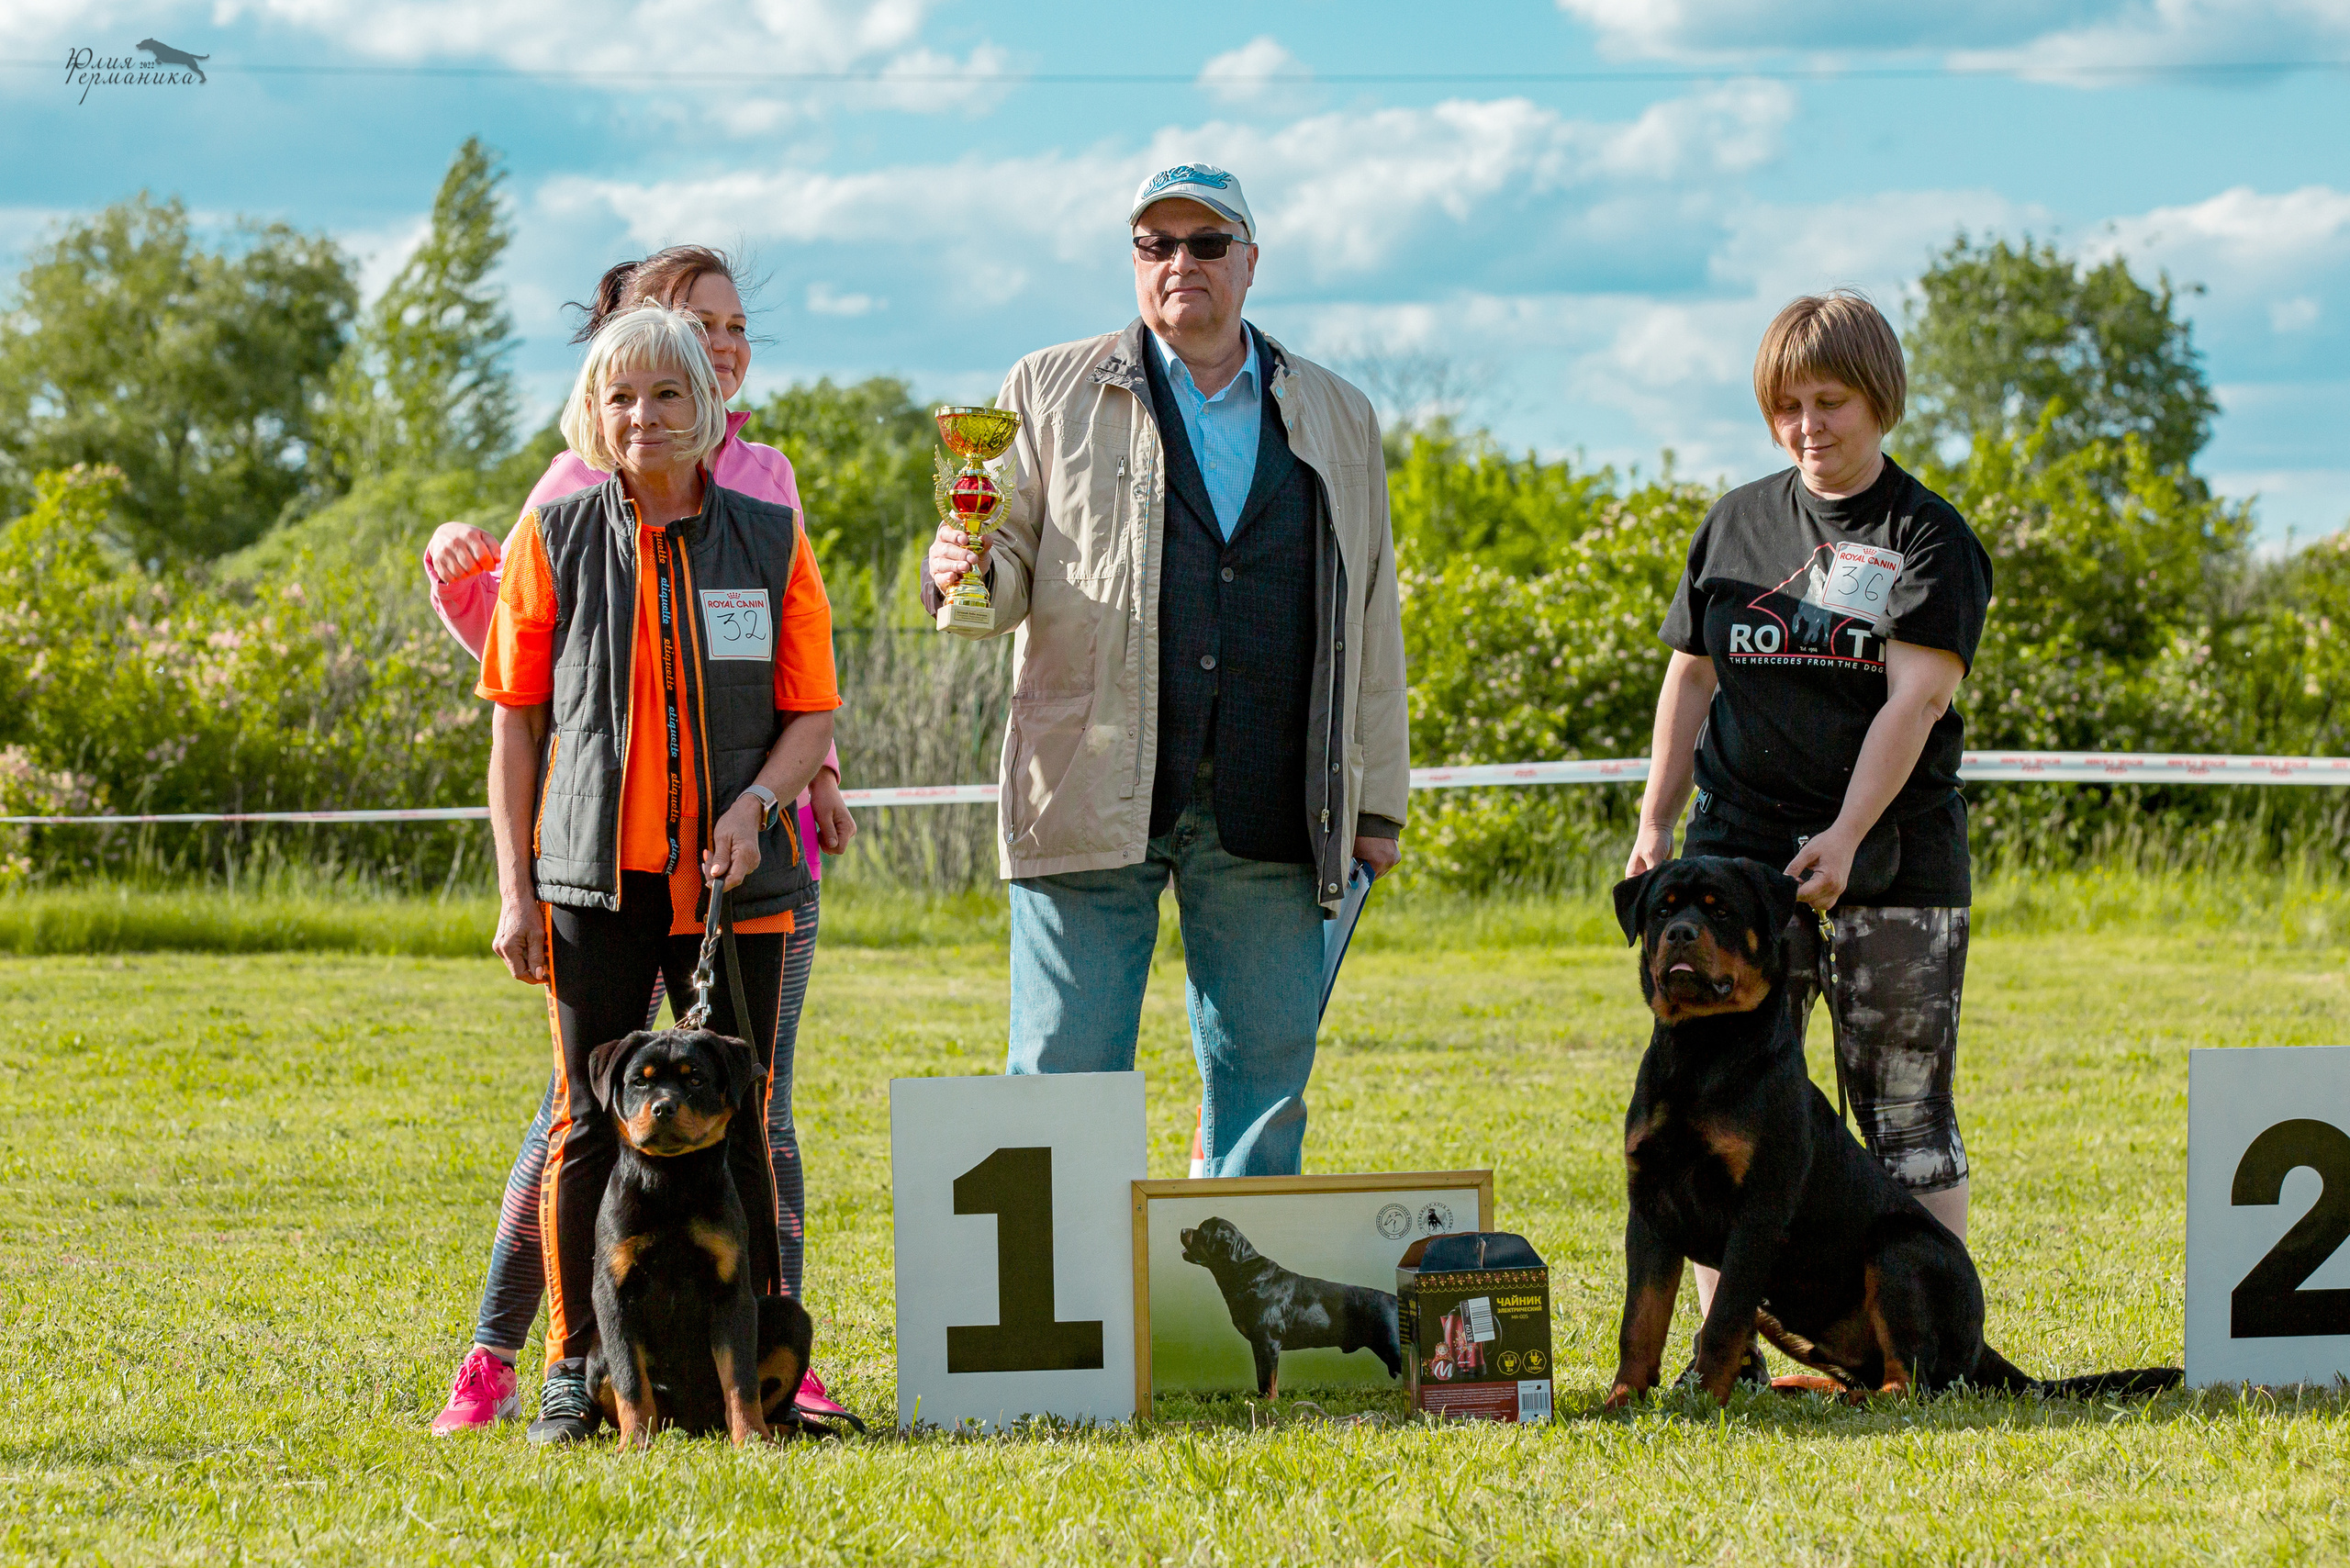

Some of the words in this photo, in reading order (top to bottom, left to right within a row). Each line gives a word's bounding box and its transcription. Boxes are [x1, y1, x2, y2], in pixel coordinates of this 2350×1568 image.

[1838, 566, 1884, 601] 36
[1840, 553, 1865, 563] ROYAL
[1867, 556, 1897, 571] CANIN
[659, 577, 671, 624] etiquette
[717, 610, 767, 641] 32
[663, 638, 675, 690] etiquette
[1838, 660, 1858, 669] THE
[1863, 664, 1886, 674] DOG
[667, 706, 679, 757] etiquette
[669, 772, 681, 823] etiquette
[2231, 1118, 2350, 1338] 2
[946, 1147, 1103, 1373] 1
[1496, 1294, 1542, 1306] ЧАЙНИК
